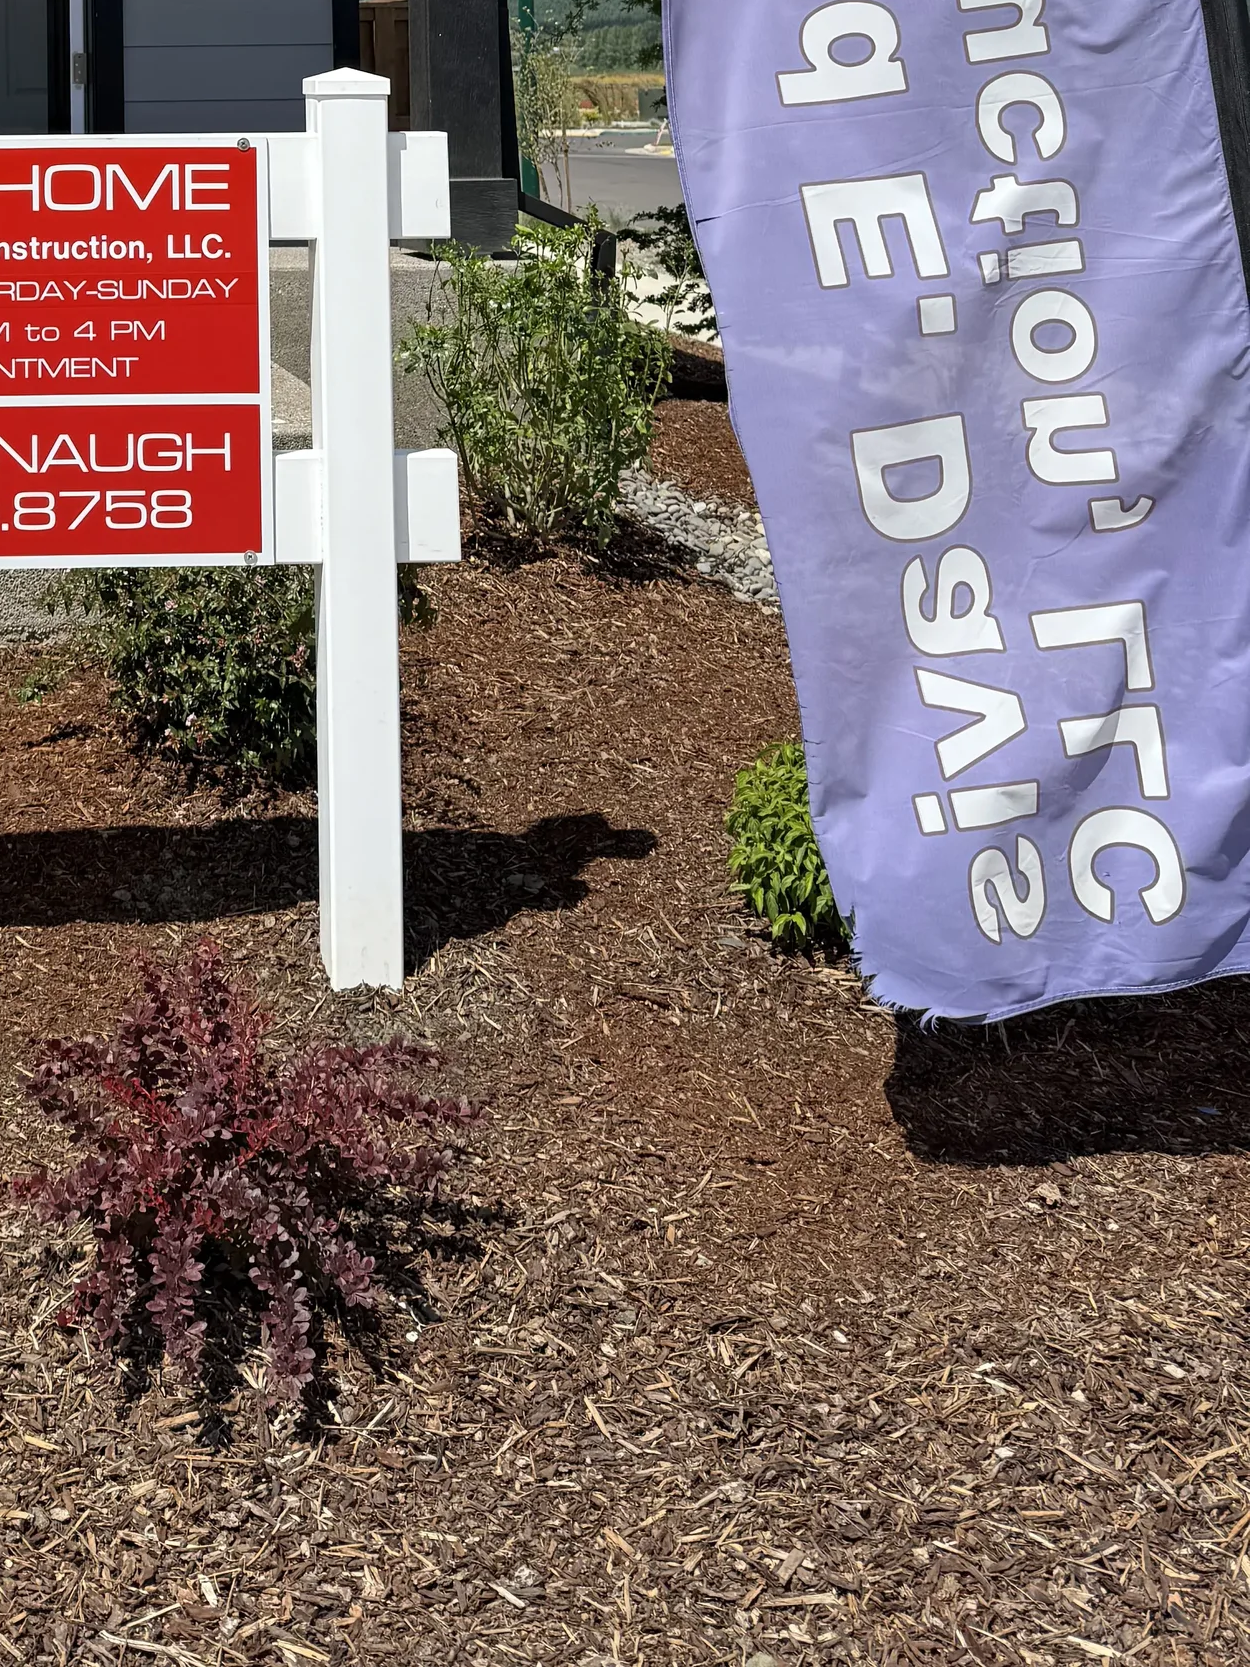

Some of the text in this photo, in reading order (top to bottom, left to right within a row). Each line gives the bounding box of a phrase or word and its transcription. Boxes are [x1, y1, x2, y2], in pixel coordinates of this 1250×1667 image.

[167, 233, 232, 259] LLC.
[24, 322, 60, 342] to
[73, 320, 97, 341] 4
[110, 320, 166, 341] PM
